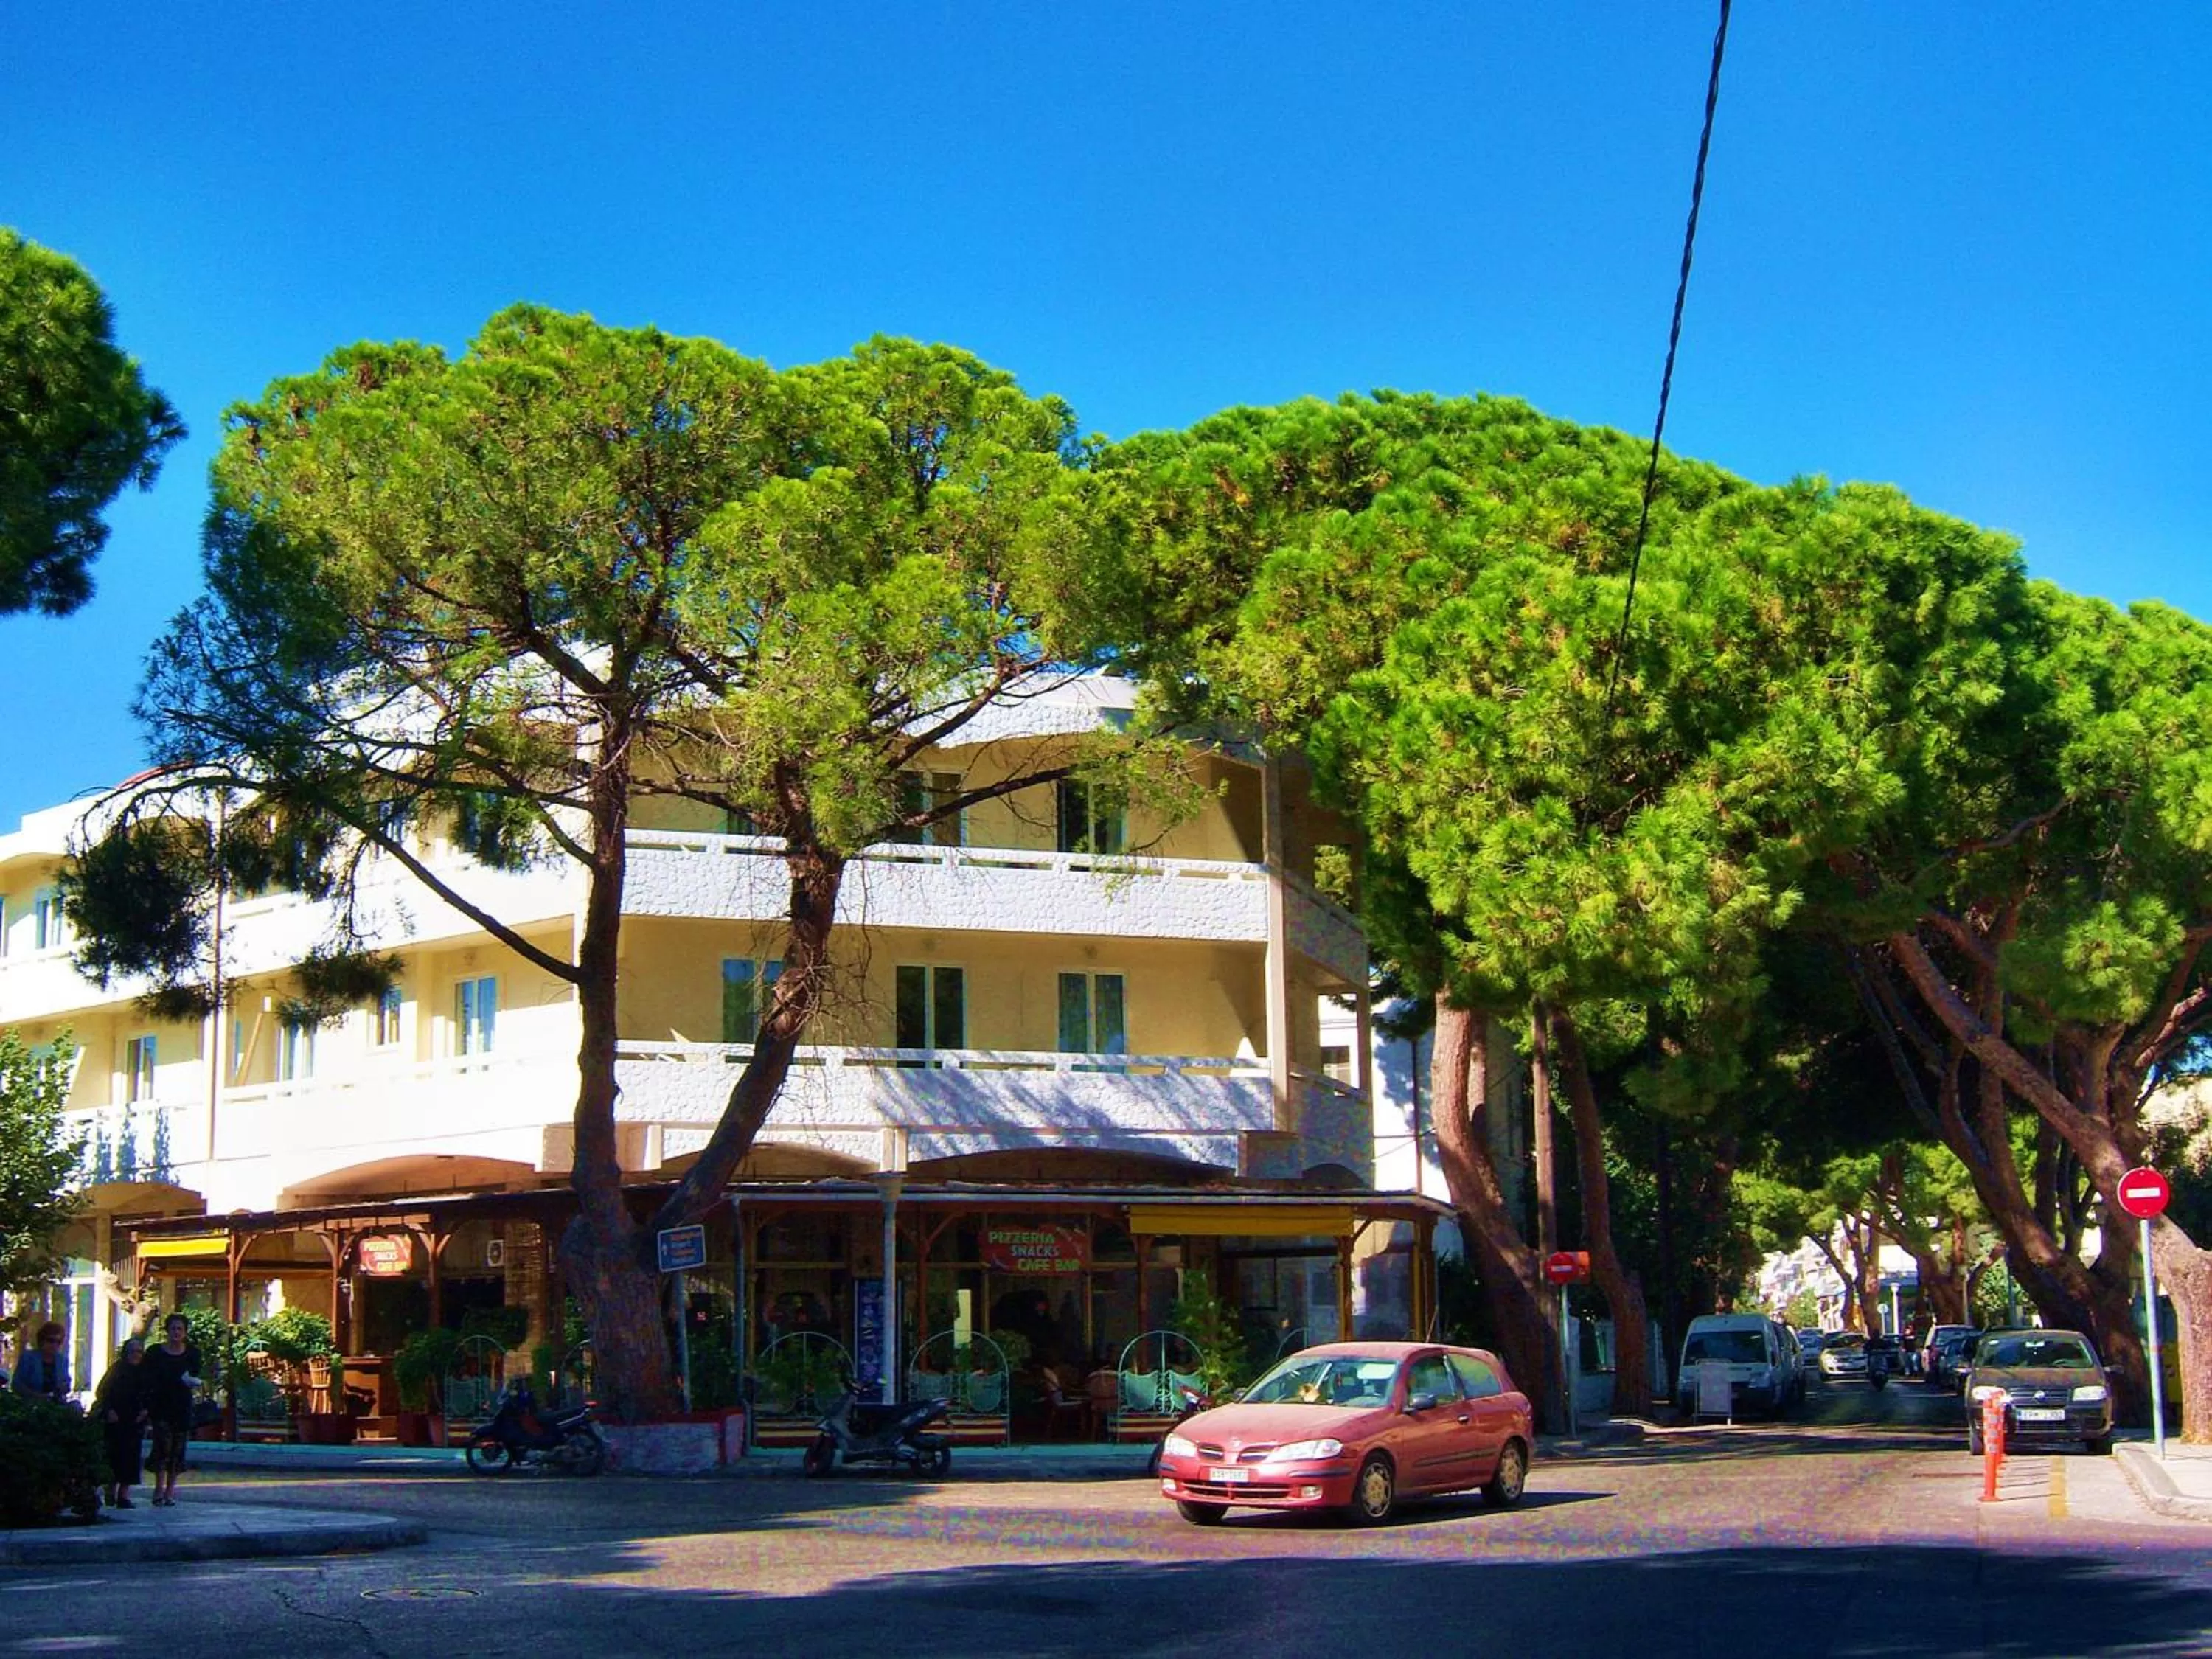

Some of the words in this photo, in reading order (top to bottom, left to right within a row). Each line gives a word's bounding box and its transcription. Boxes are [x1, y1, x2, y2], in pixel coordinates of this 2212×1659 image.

[988, 1231, 1055, 1244] PIZZERIA
[1011, 1244, 1060, 1257] SNACKS
[1018, 1258, 1051, 1271] CAFE
[1055, 1258, 1081, 1272] BAR
